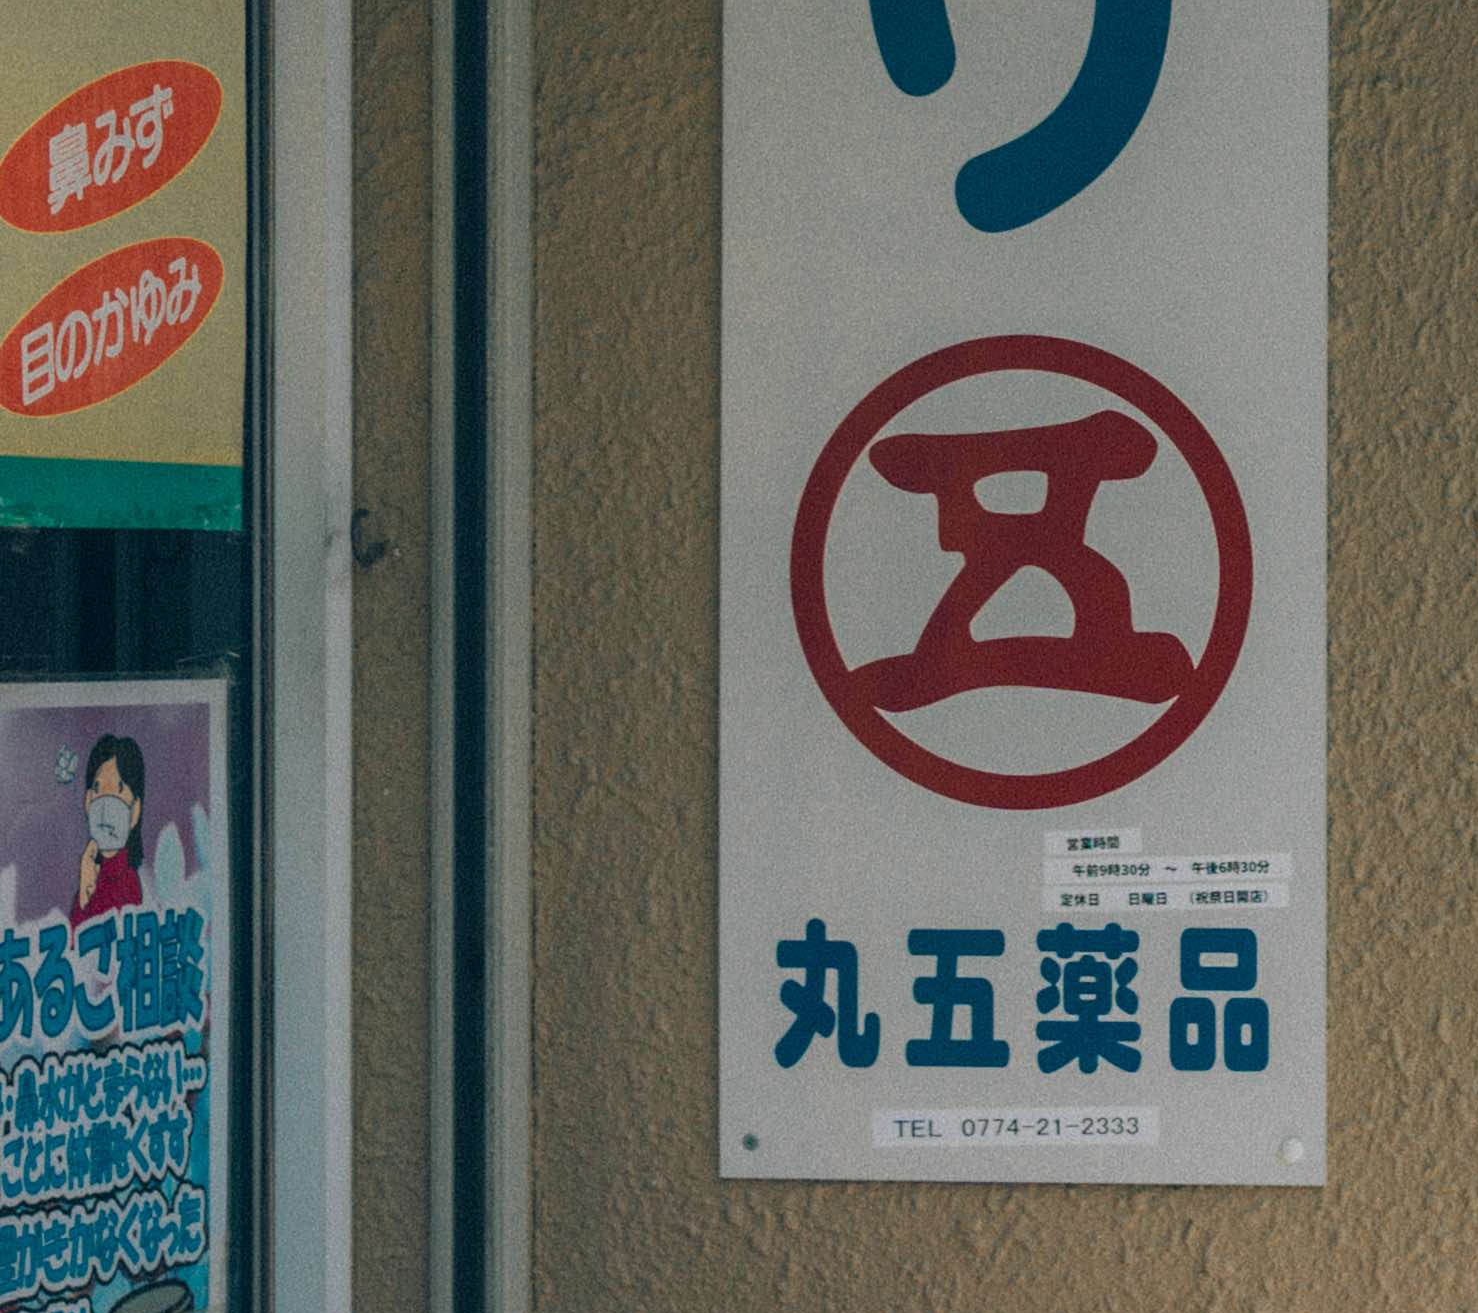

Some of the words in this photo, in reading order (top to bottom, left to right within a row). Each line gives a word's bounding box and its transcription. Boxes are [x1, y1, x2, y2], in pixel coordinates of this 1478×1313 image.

[48, 84, 173, 214] 鼻みず
[20, 256, 202, 406] 目のかゆみ
[1066, 835, 1121, 851] 営業時間
[1060, 892, 1101, 907] 定休日
[1128, 891, 1168, 906] 日曜日
[775, 918, 1270, 1075] 丸五薬品
[894, 1118, 942, 1140] TEL
[960, 1116, 1140, 1139] 0774-21-2333
